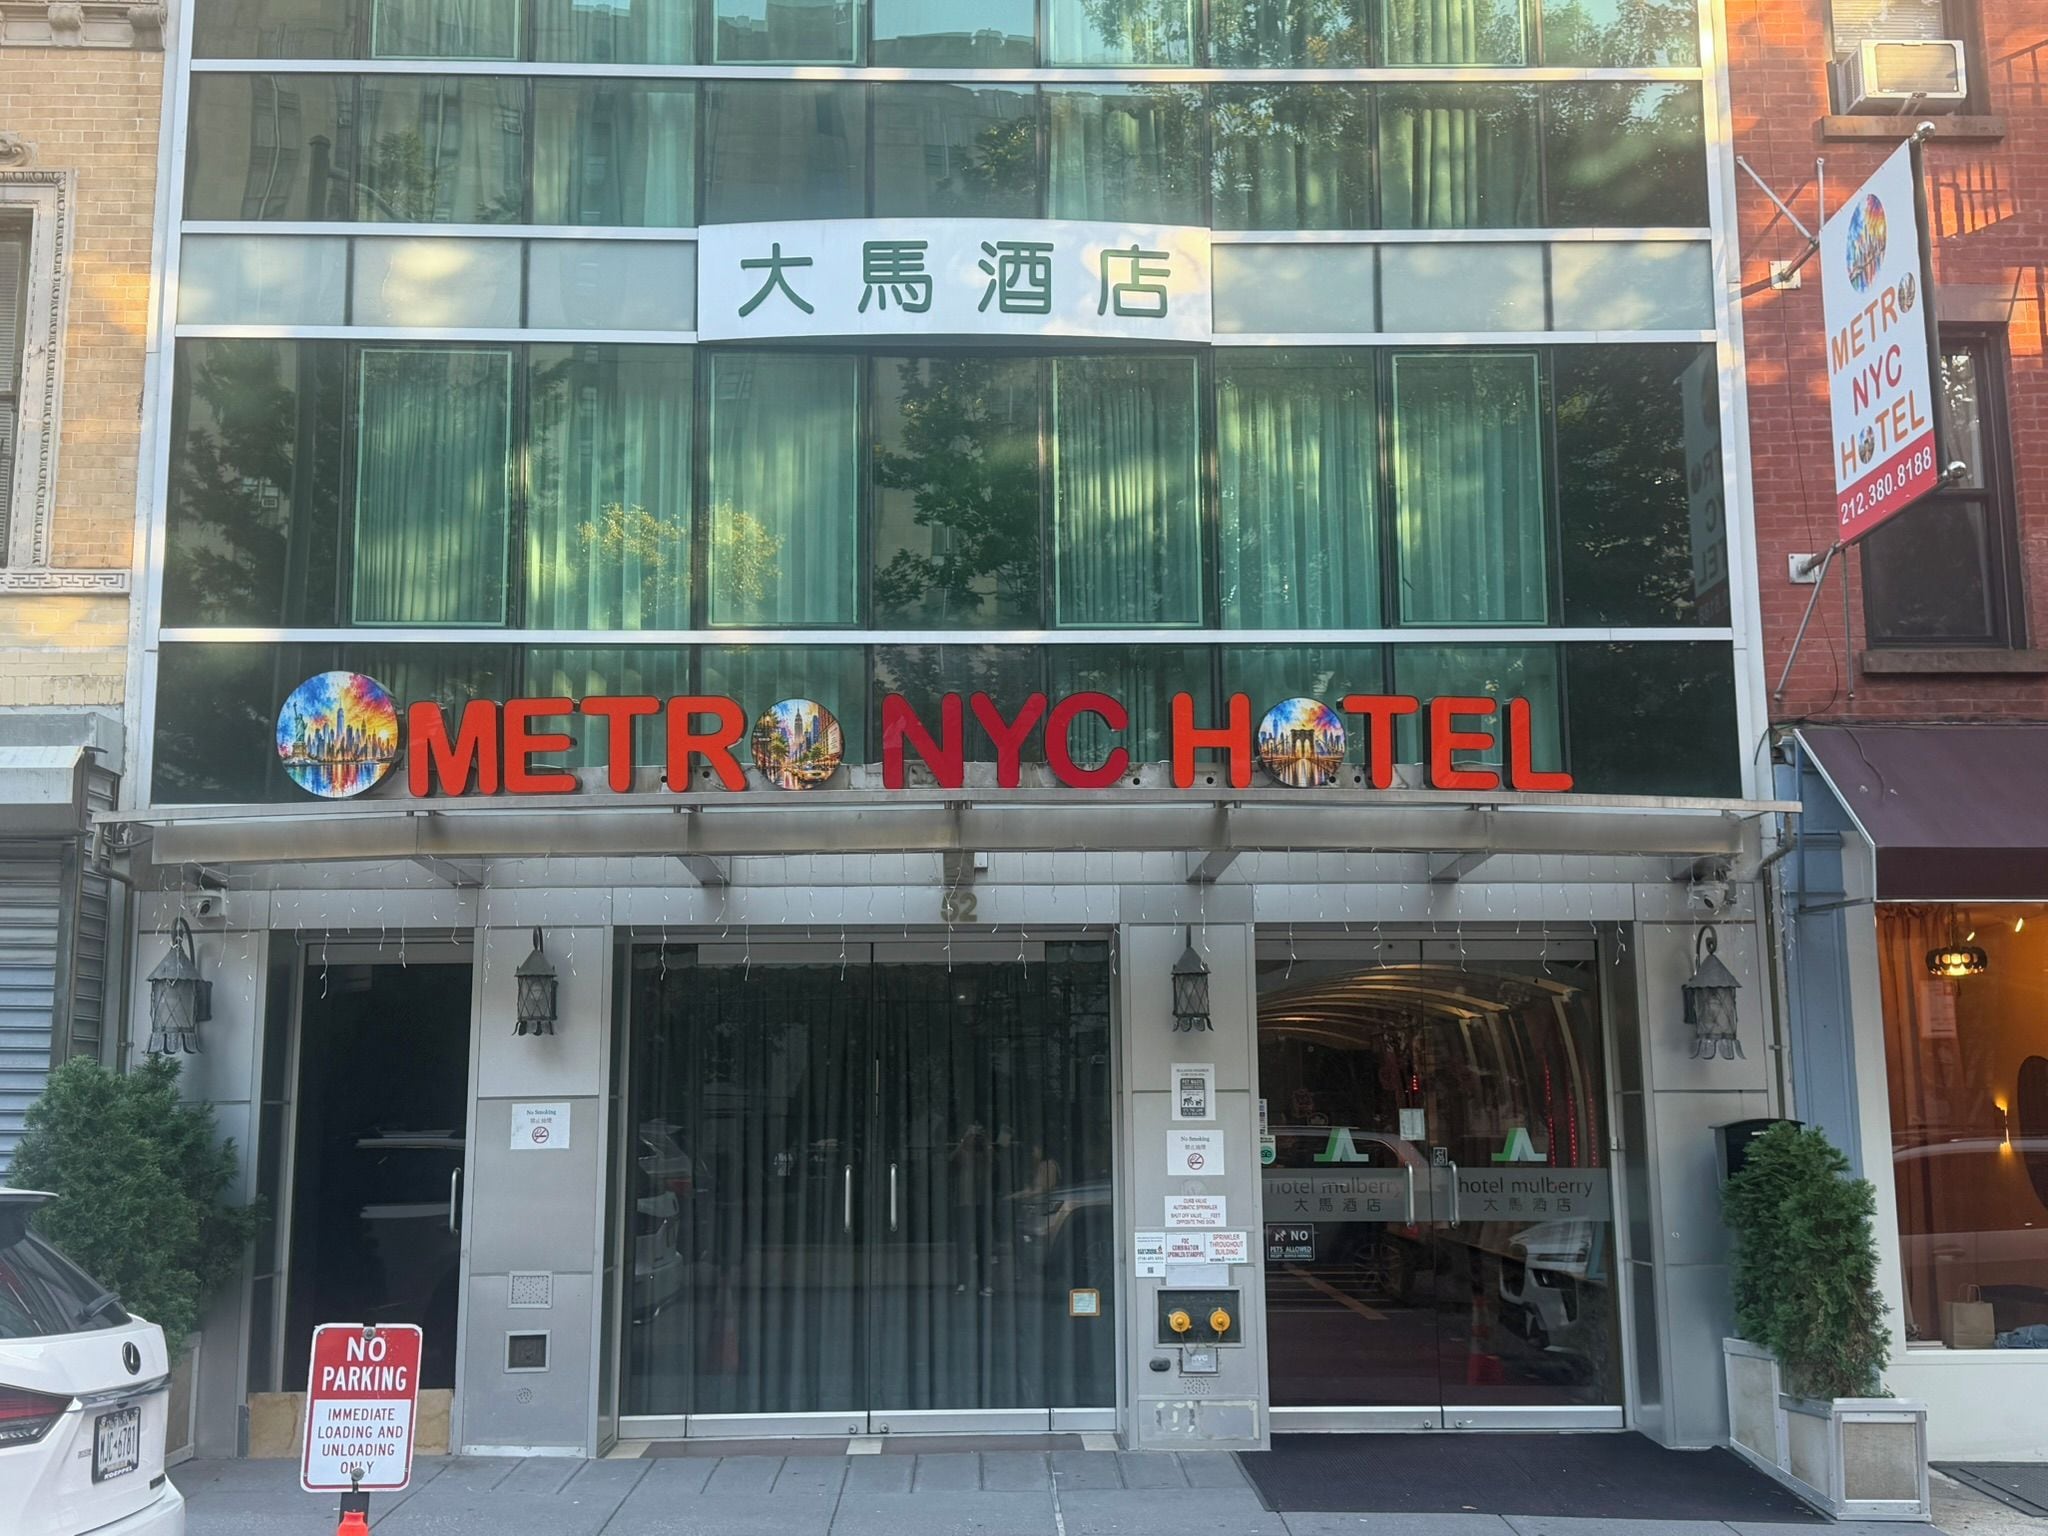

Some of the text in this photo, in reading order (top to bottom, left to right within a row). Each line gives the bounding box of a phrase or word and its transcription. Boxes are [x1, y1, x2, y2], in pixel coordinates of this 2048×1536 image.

[738, 240, 1171, 318] 大馬酒店
[1852, 344, 1903, 416] NYC
[1840, 446, 1932, 526] 212.380.8188
[881, 690, 1130, 790] NYC
[1458, 1176, 1593, 1198] hotel mulberry
[1290, 1229, 1309, 1241] NO
[346, 1336, 387, 1362] NO
[321, 1365, 408, 1392] PARKING
[327, 1407, 396, 1422] IMMEDIATE
[317, 1425, 404, 1439] LOADING AND
[321, 1442, 396, 1457] UNLOADING
[340, 1460, 375, 1475] ONY
